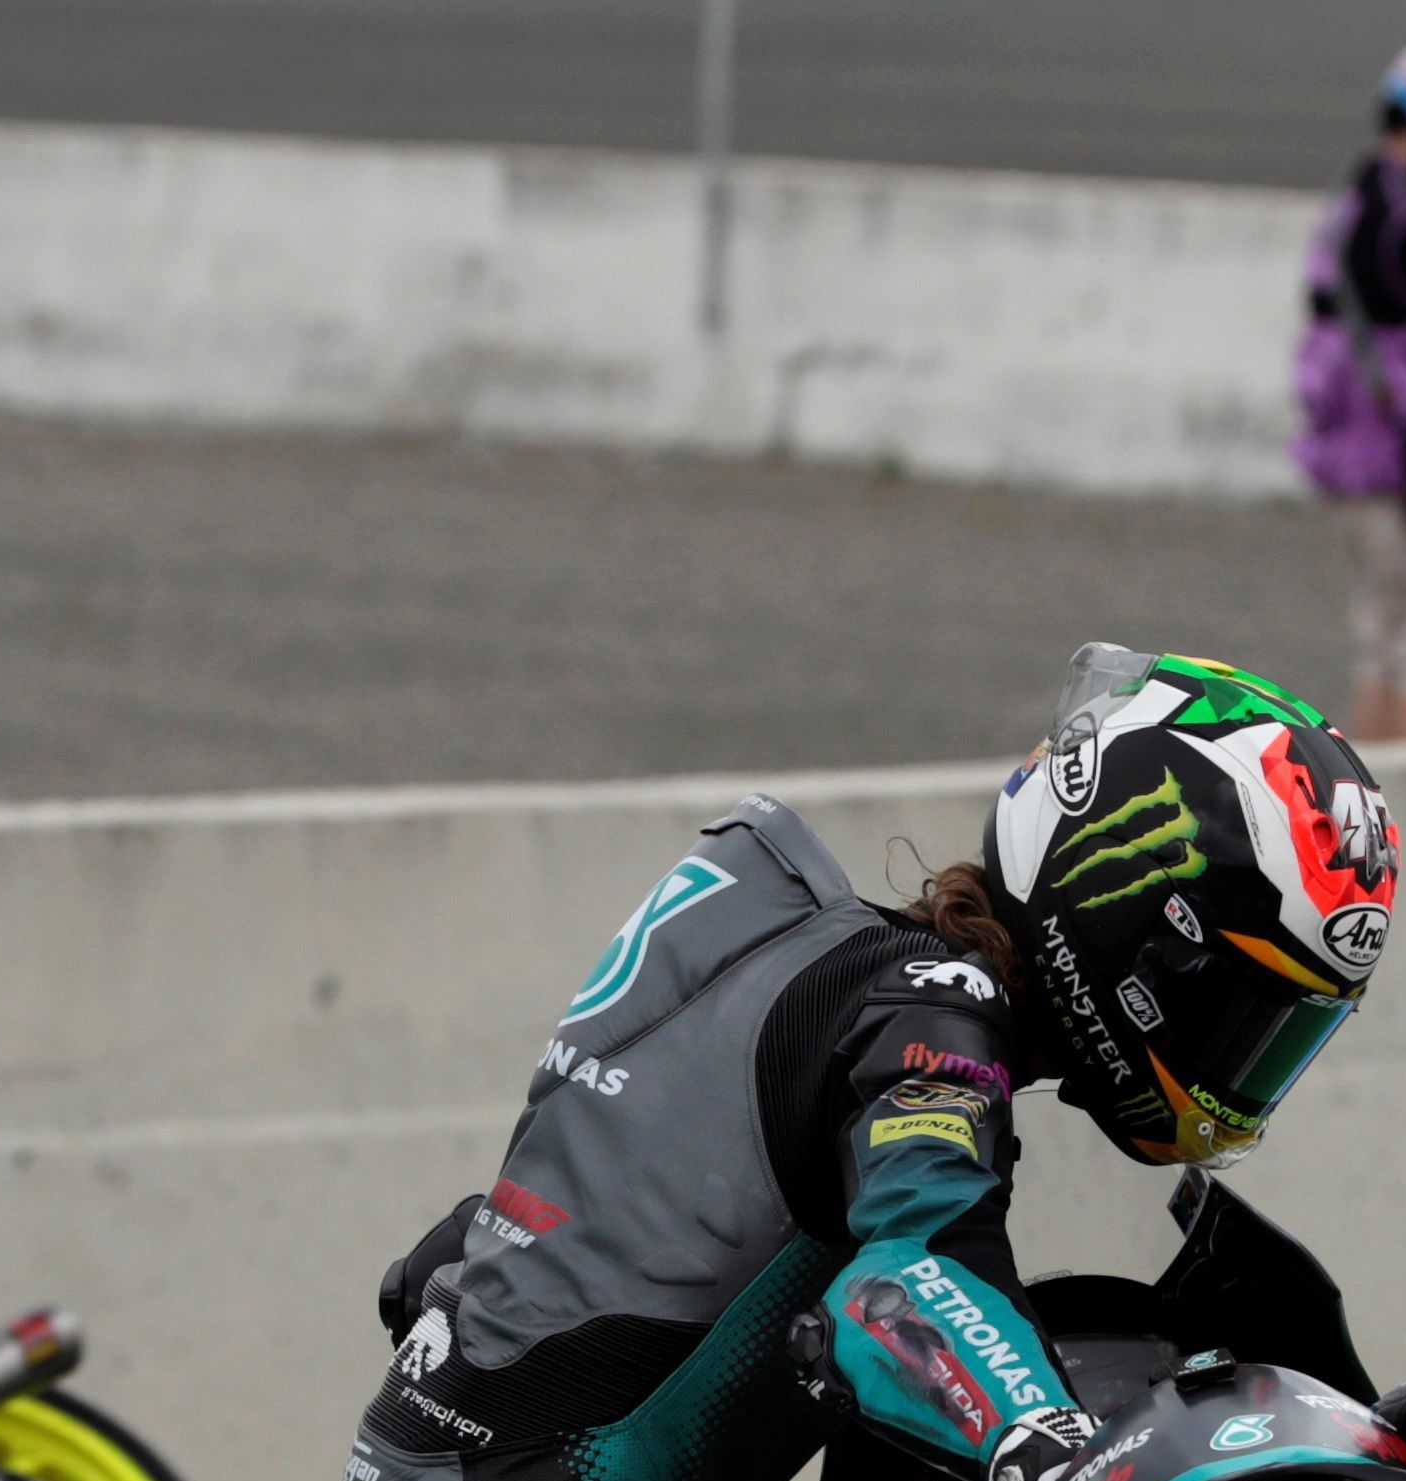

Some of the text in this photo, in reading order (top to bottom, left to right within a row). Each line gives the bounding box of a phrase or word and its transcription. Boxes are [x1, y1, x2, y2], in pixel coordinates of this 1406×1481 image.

[1042, 914, 1132, 1086] MONSTER
[1122, 983, 1159, 1024] 100%
[900, 1256, 1046, 1407] PETRONAS
